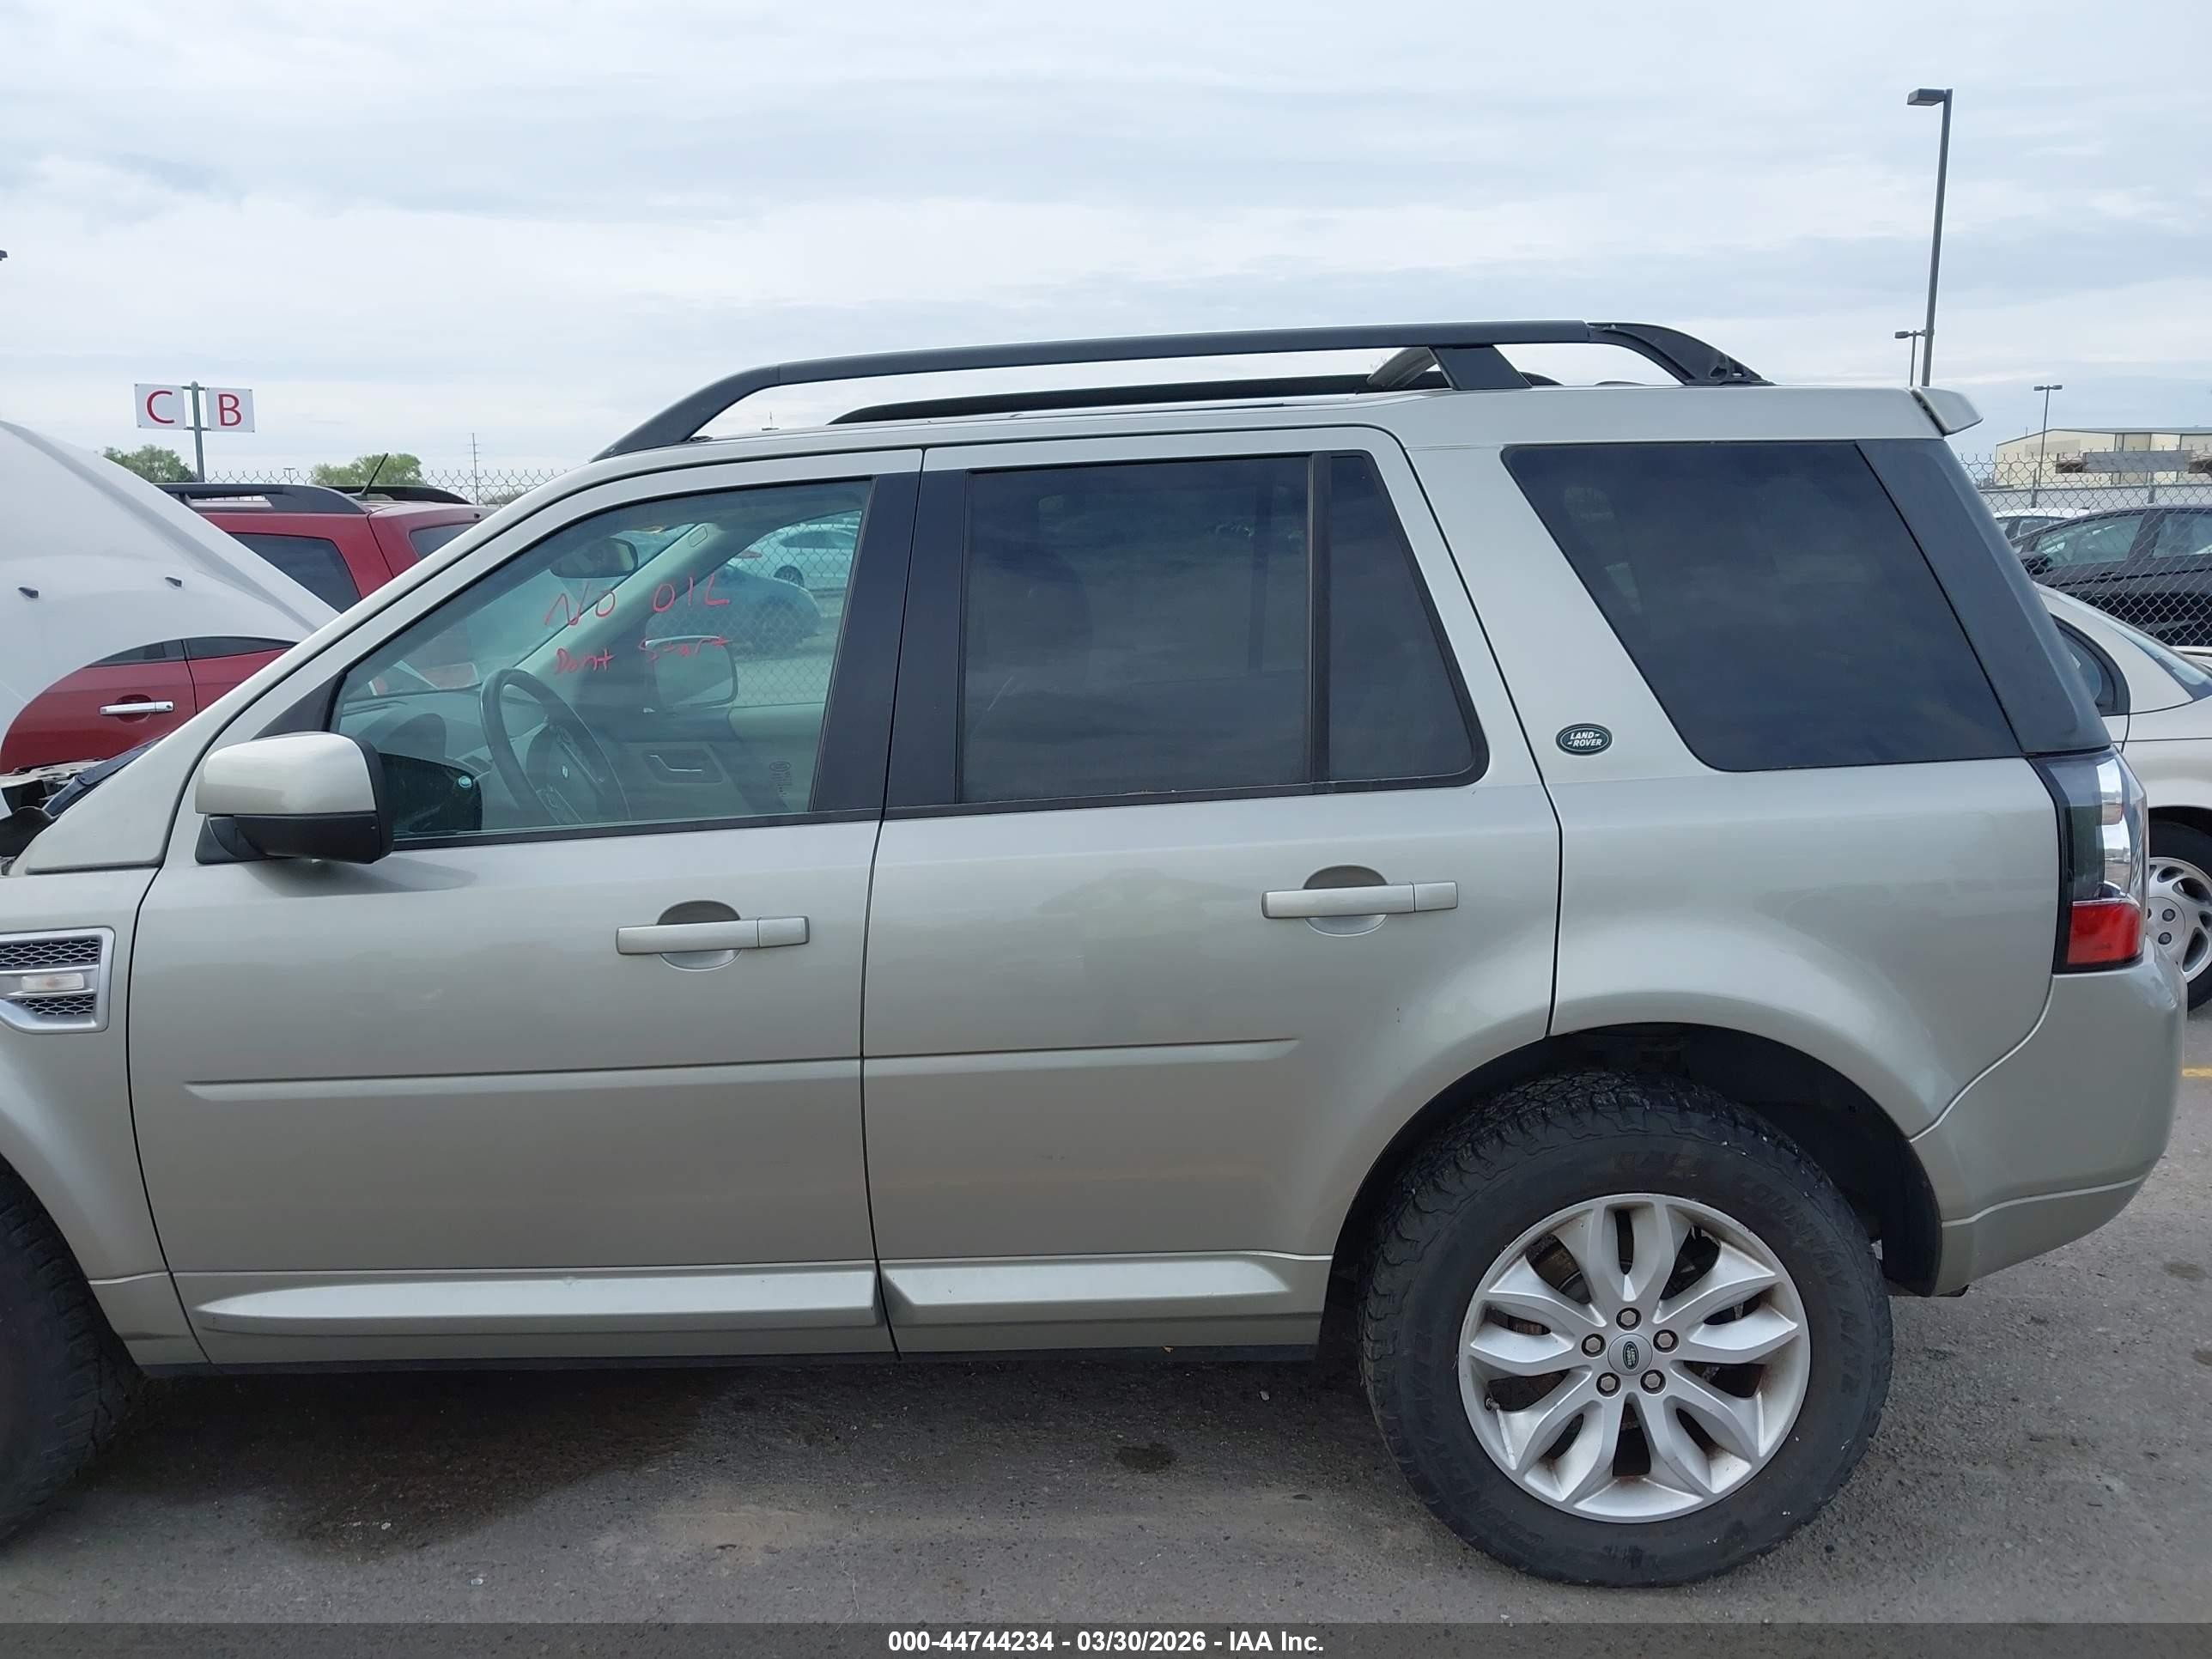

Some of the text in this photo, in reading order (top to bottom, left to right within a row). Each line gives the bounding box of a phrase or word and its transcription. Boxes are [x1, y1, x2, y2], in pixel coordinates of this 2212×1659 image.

[146, 390, 175, 424] C
[218, 393, 243, 427] B
[544, 573, 730, 626] NO OIL
[1570, 732, 1595, 740] LAND
[1572, 738, 1602, 747] ROVER
